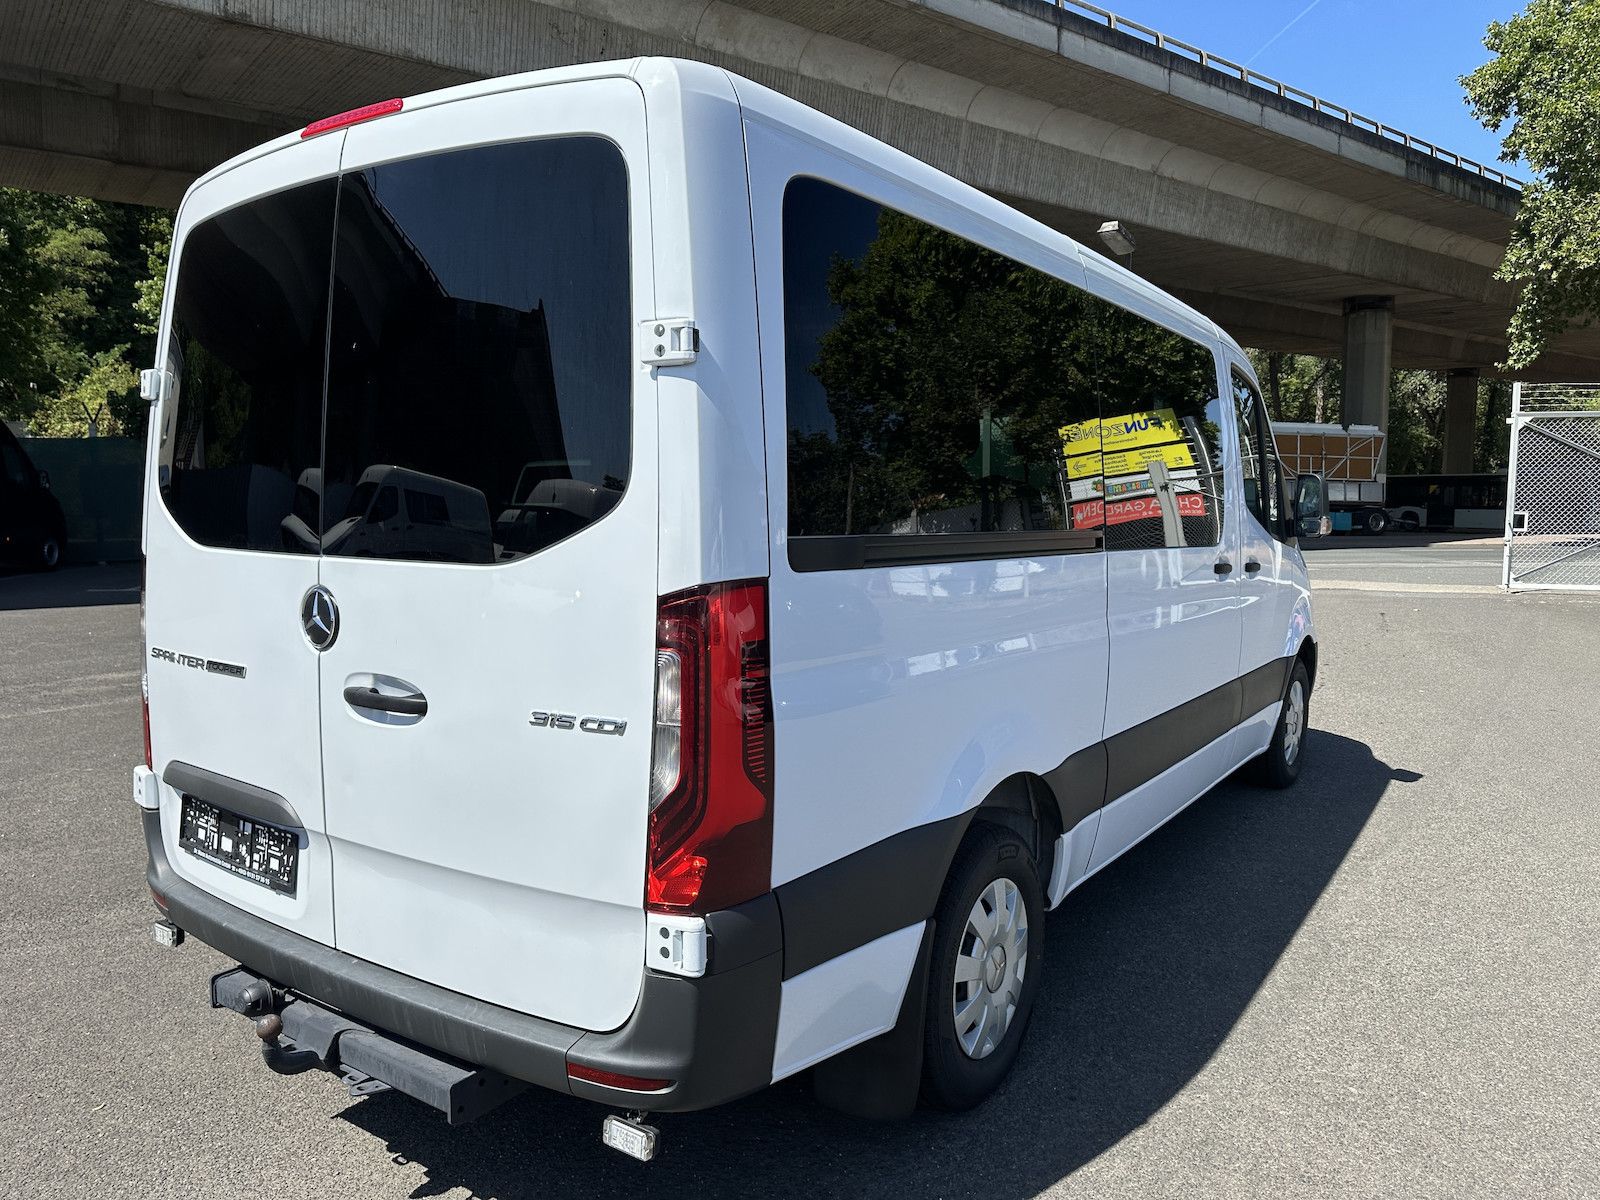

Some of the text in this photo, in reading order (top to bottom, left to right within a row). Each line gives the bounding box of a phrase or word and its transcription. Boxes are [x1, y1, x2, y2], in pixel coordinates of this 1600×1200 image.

[151, 647, 204, 671] SPRINTER
[529, 711, 628, 737] 315 CDI
